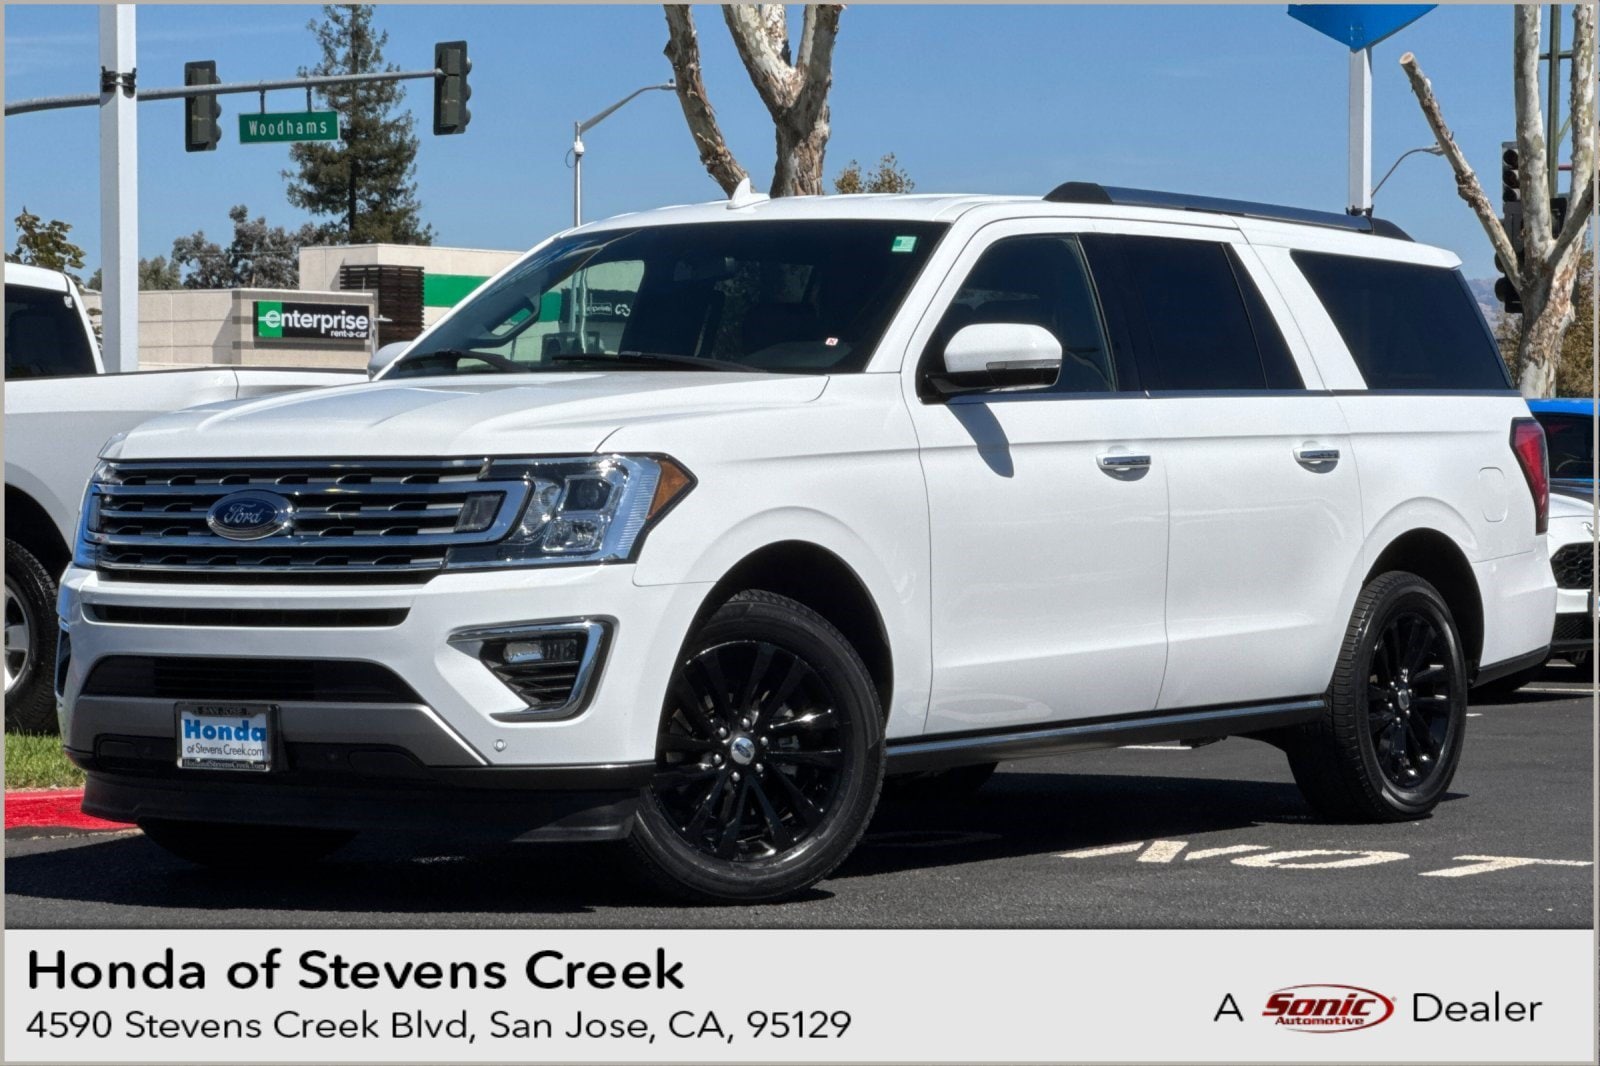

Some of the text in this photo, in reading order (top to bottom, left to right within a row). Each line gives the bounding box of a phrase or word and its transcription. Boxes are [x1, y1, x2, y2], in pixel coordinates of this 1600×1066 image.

[248, 119, 327, 137] Woodhams
[258, 309, 368, 334] enterprise
[330, 329, 367, 338] rent-a-car
[223, 503, 265, 524] Ford
[184, 719, 267, 742] Honda
[186, 744, 195, 754] of
